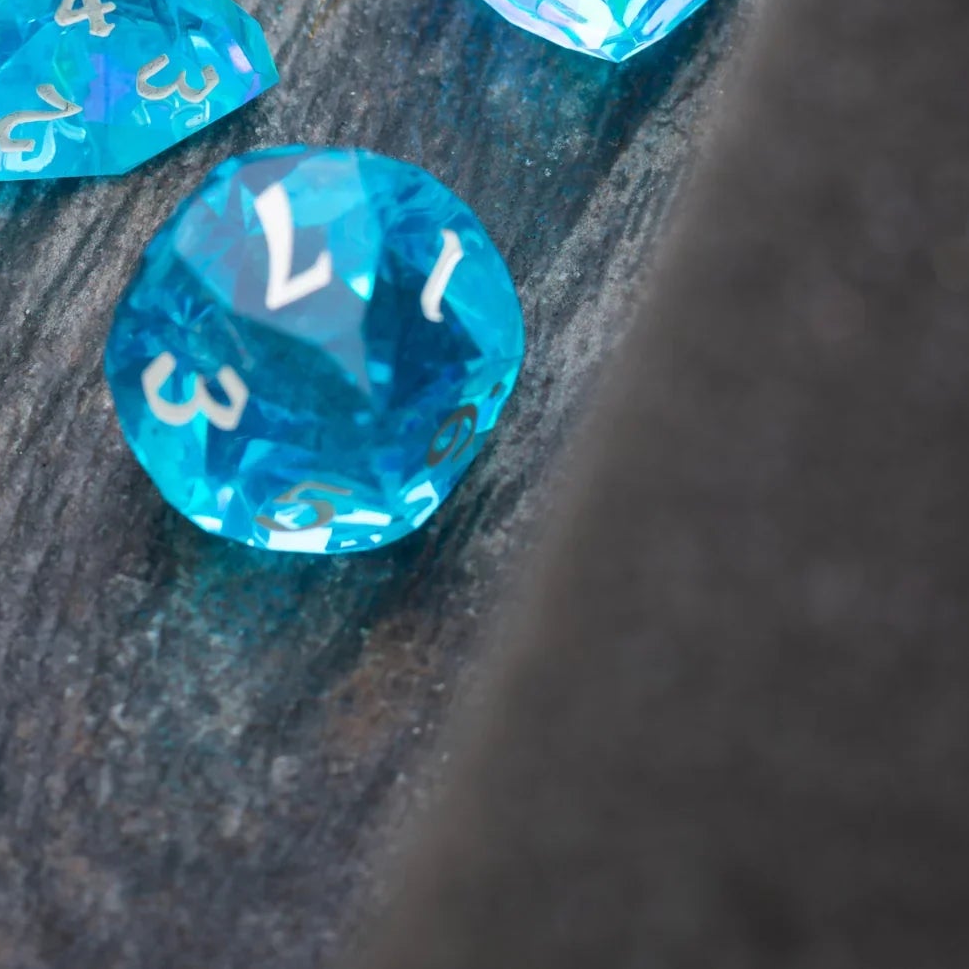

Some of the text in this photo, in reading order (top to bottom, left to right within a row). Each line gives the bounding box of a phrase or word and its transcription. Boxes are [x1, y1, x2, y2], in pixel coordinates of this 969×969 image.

[136, 54, 220, 103] 3
[253, 182, 333, 310] 7
[421, 229, 464, 323] 1
[141, 351, 249, 431] 3
